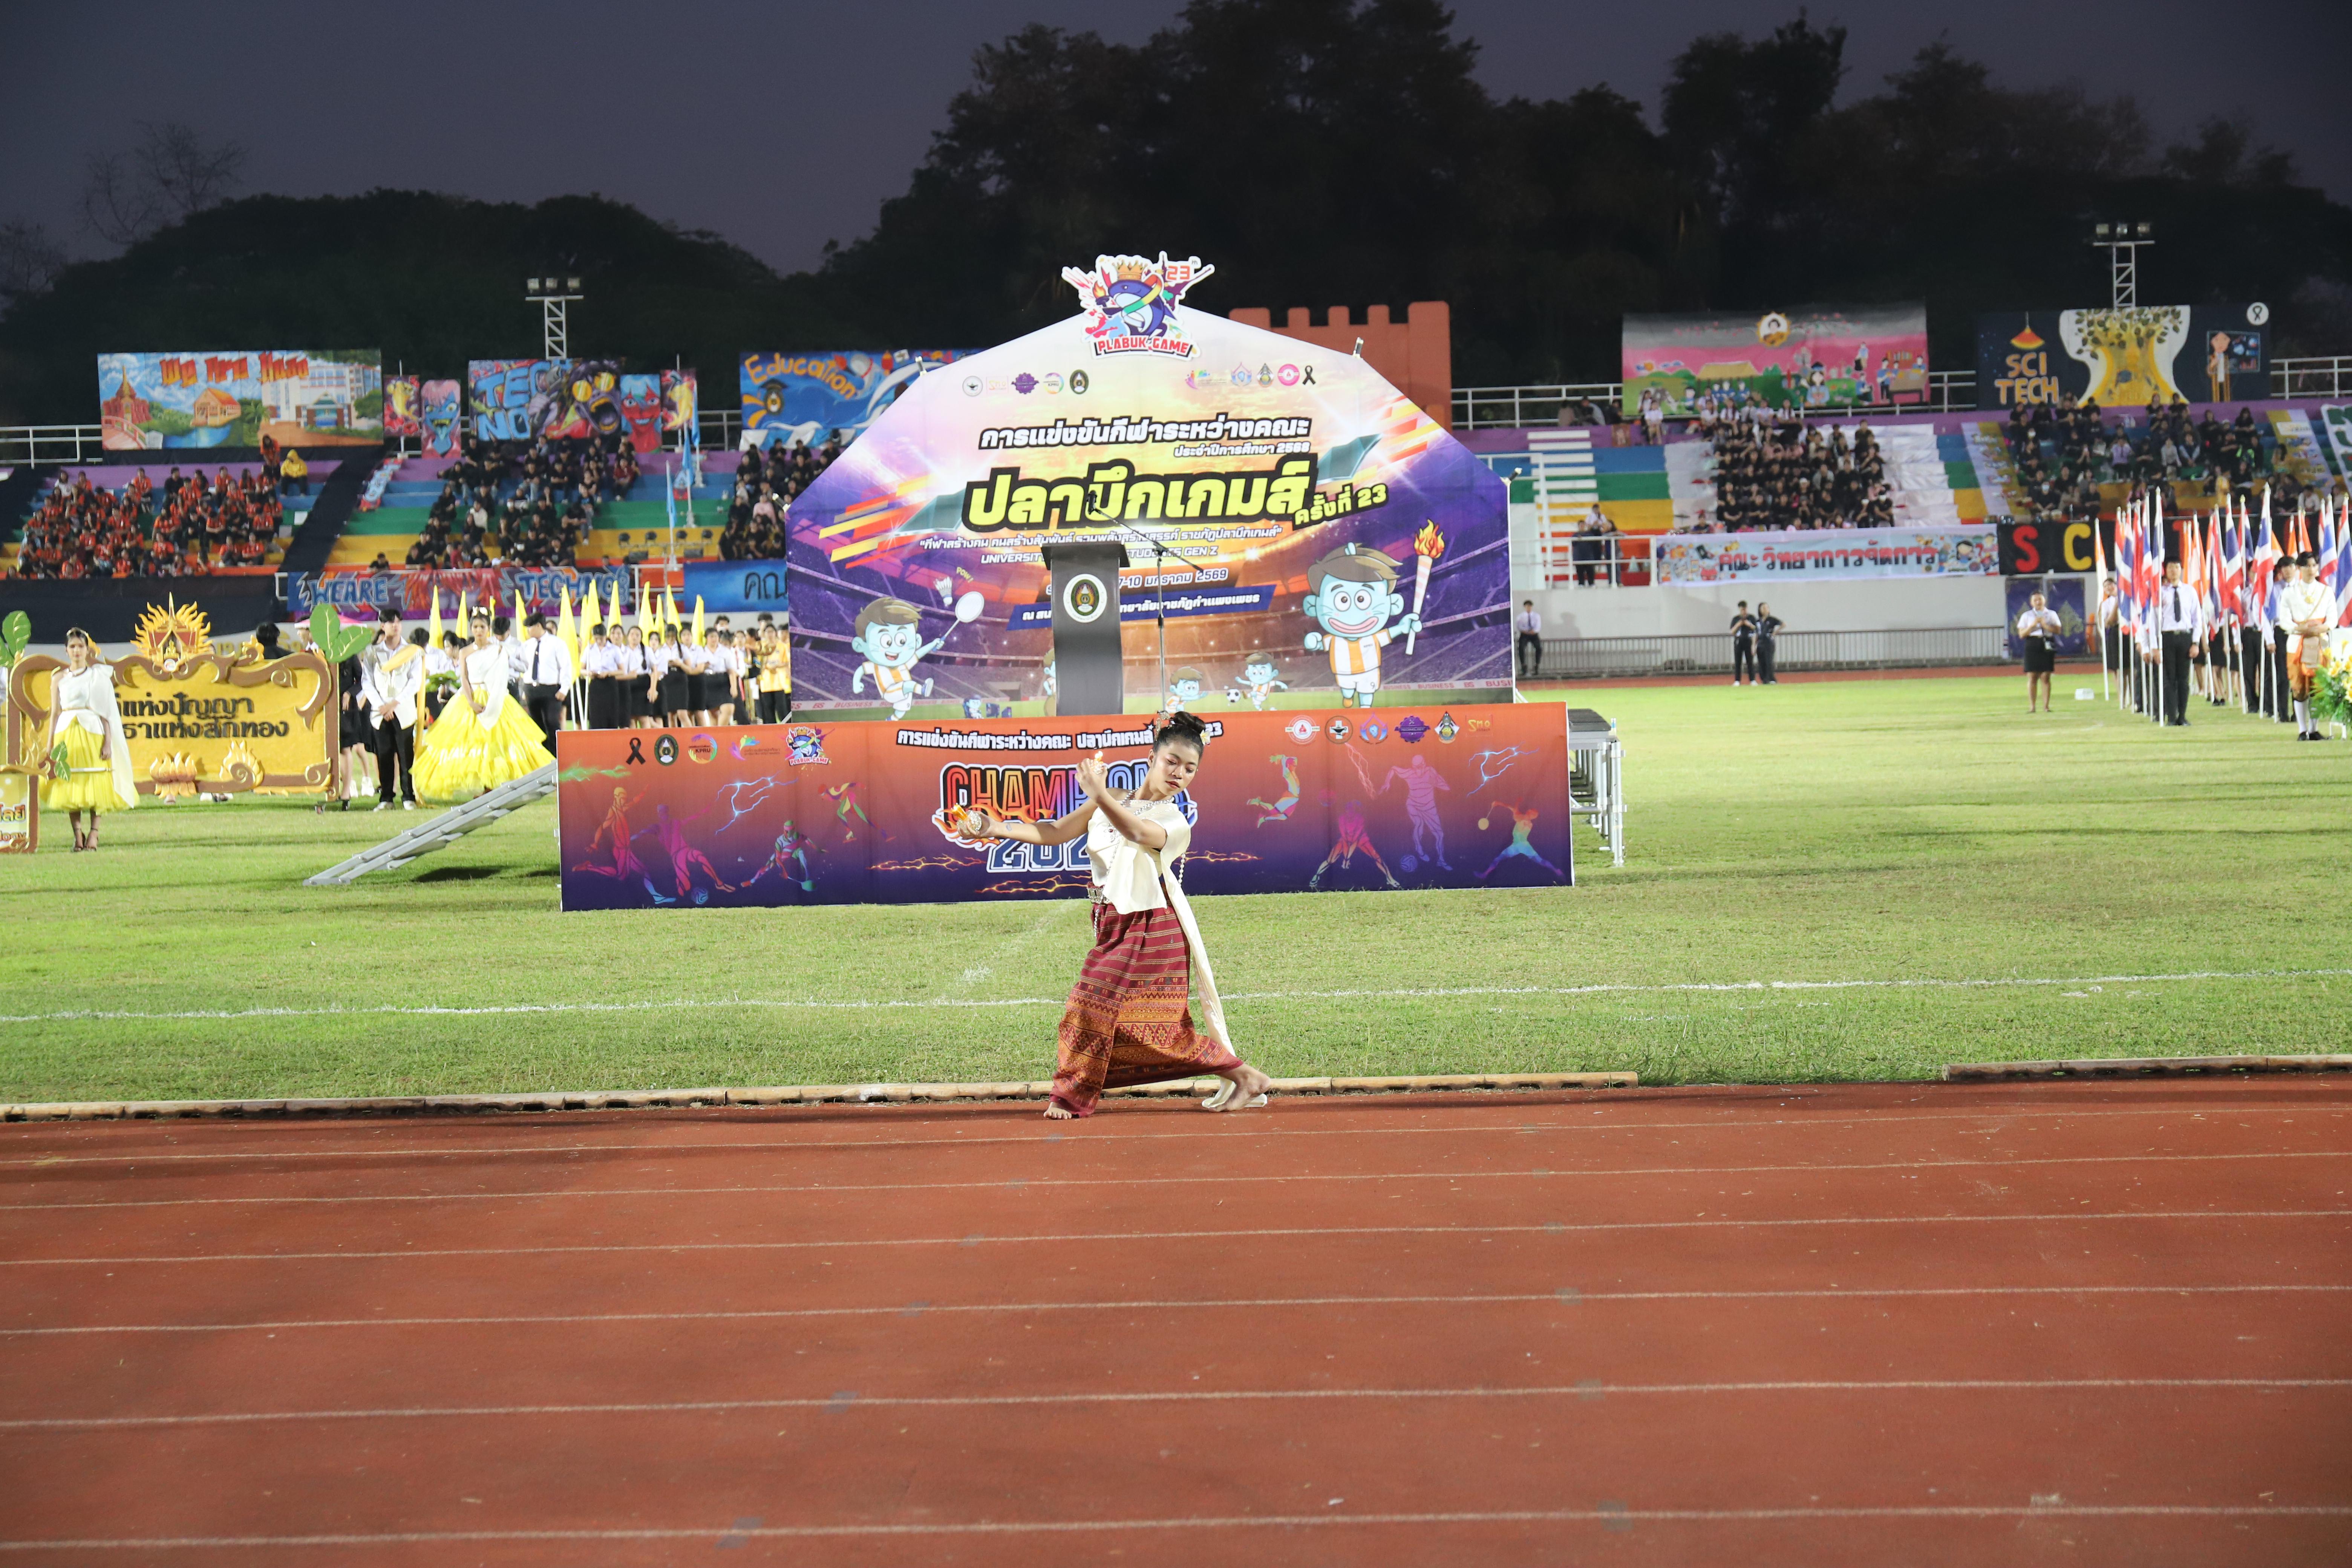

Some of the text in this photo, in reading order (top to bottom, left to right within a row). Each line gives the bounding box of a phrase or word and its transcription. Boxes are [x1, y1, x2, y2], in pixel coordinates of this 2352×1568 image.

[1166, 266, 1190, 280] 23
[1098, 337, 1189, 354] PLABUK GAME
[2005, 351, 2047, 377] SCI
[740, 353, 858, 400] Education
[1994, 376, 2060, 405] TECH
[980, 414, 1310, 448] การแข่งขันกีฬาระหว่างคณะ
[1174, 441, 1310, 457] ประจำปีการศึกษา 2568
[966, 459, 1311, 528] ปลาบึกเกมส์
[1295, 484, 1387, 525] ครั้งที่ 23
[1184, 547, 1208, 557] GEN
[1209, 546, 1218, 556] Z
[956, 566, 974, 583] POW!
[1197, 569, 1227, 582] 2569
[1022, 611, 1035, 621] ณ
[897, 728, 1072, 750] การแข่งขันกีฬาระหว่างคณะ
